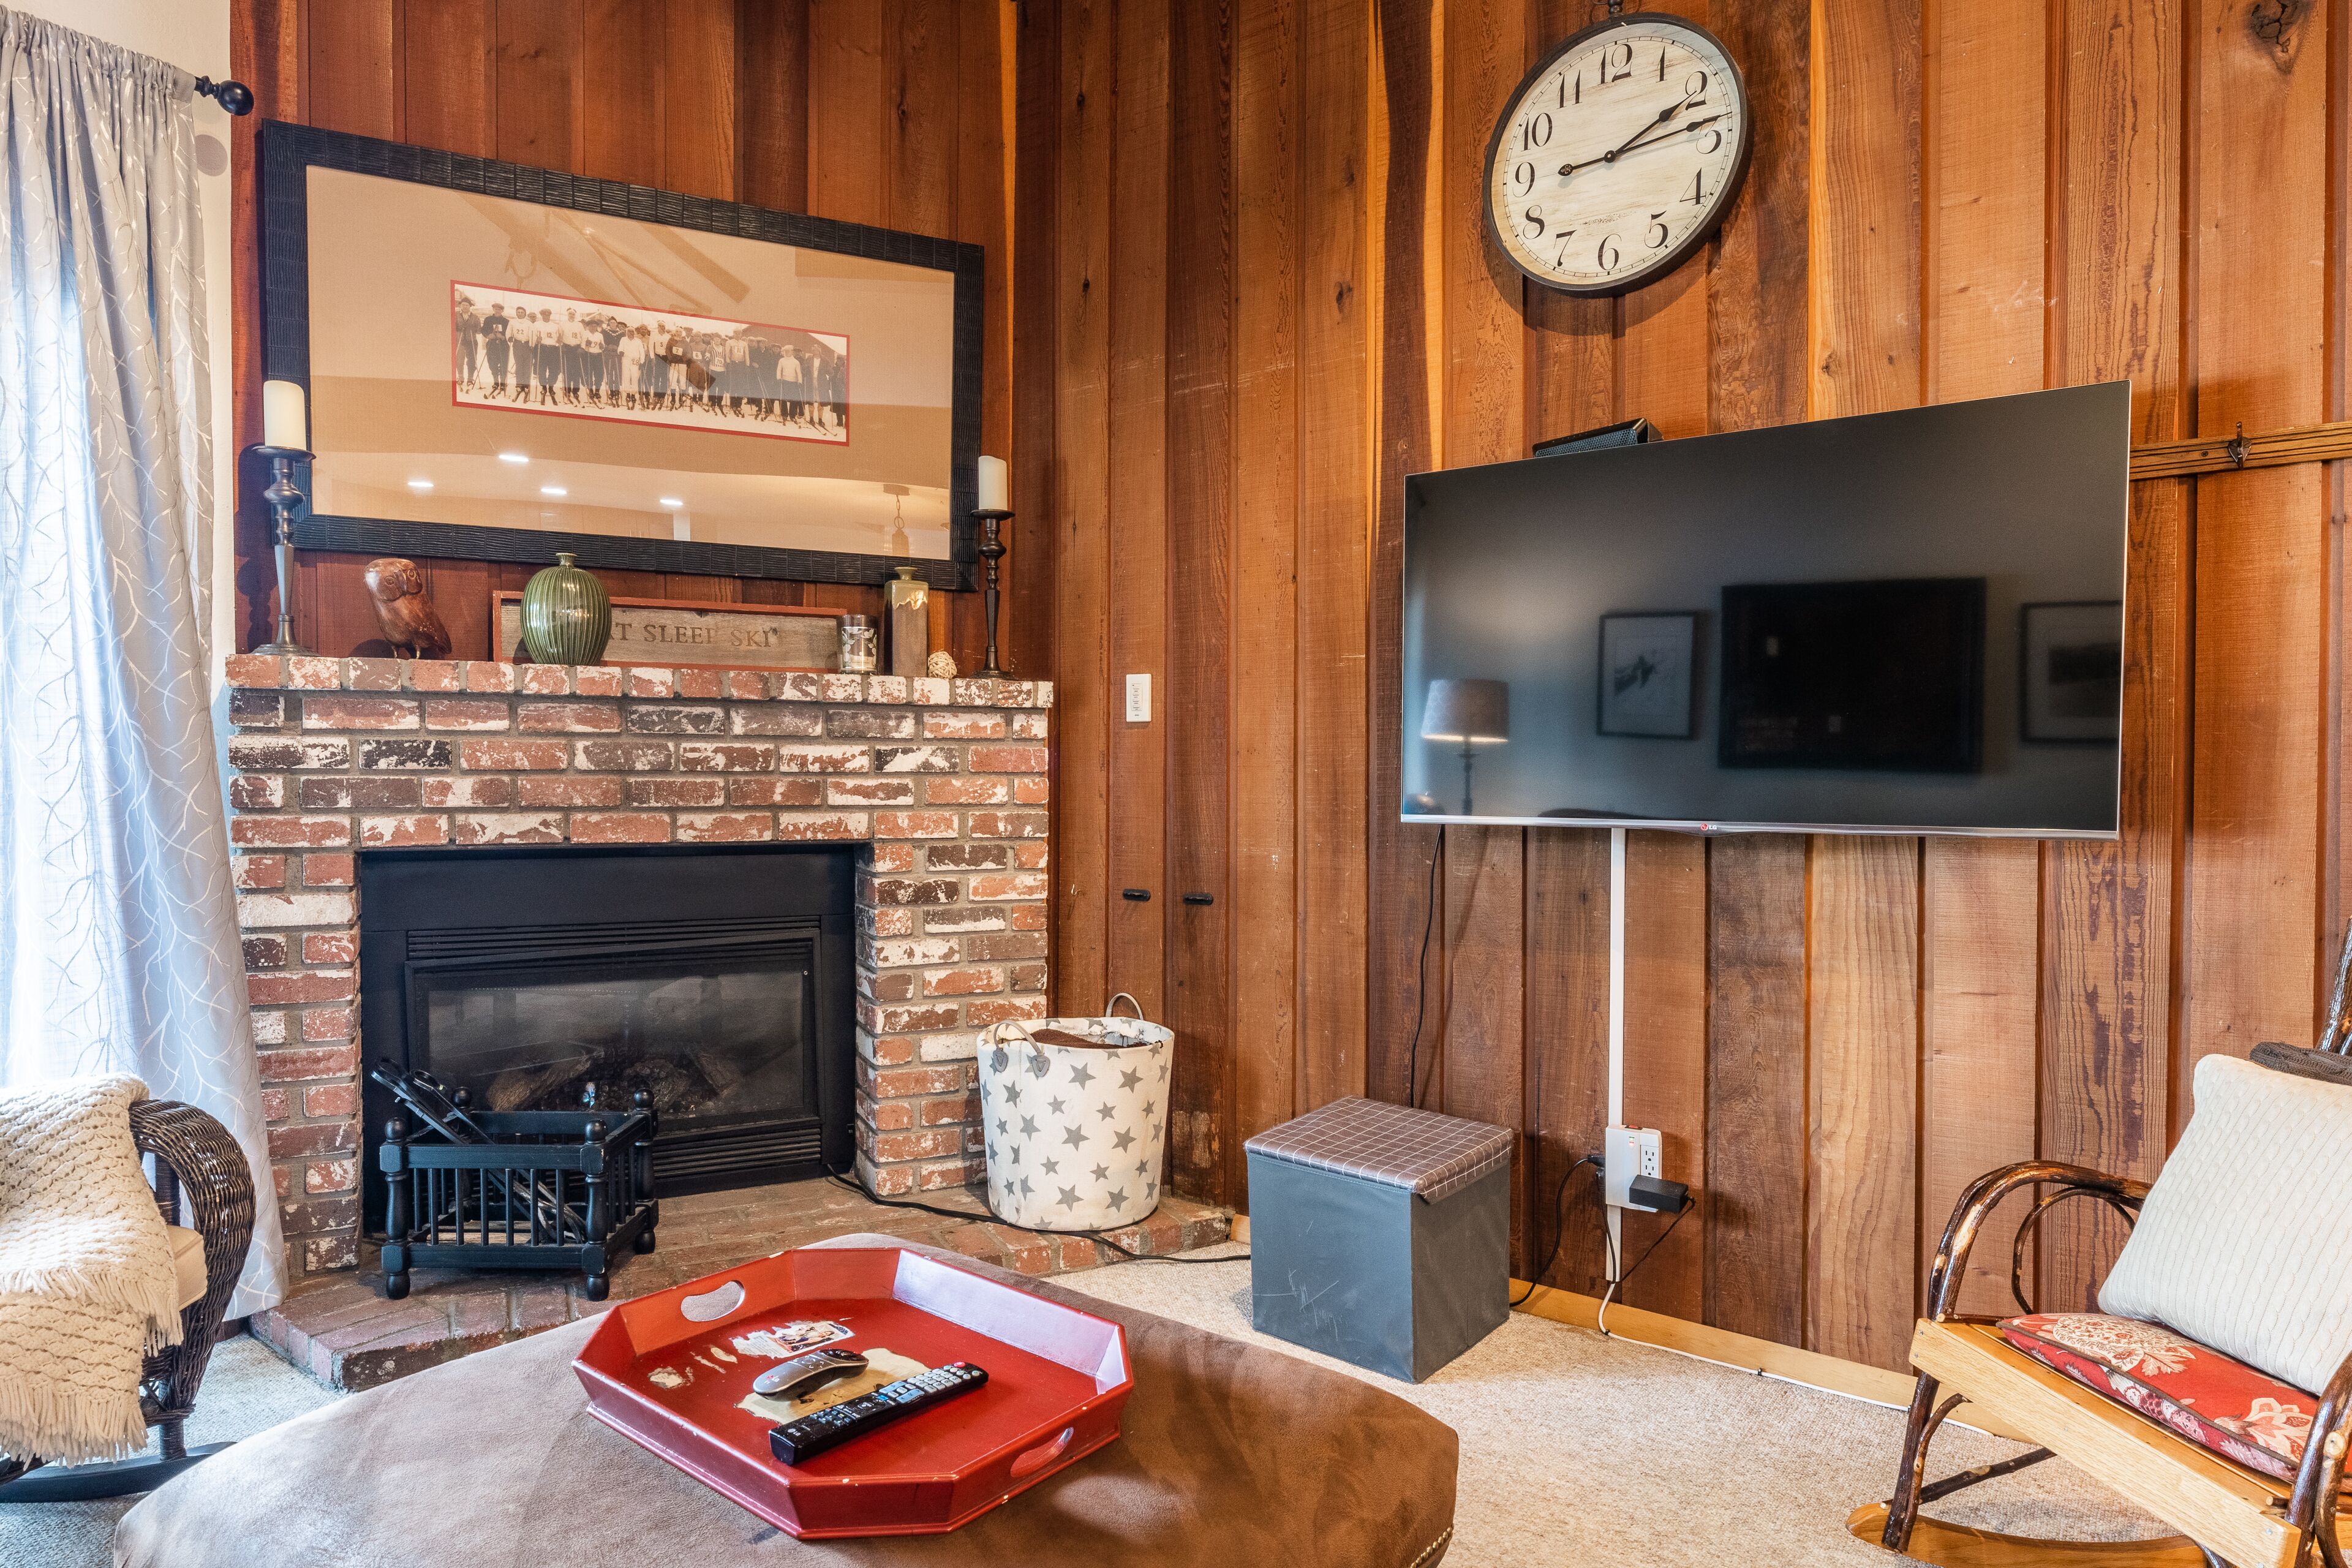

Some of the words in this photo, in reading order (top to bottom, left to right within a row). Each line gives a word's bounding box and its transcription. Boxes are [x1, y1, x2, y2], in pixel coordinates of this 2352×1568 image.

[1598, 43, 1633, 85] 12
[1656, 45, 1667, 83] 1
[1556, 69, 1582, 109] 11
[1684, 70, 1708, 111] 2
[1521, 112, 1553, 152] 10
[1695, 115, 1722, 154] 3
[1512, 161, 1536, 198] 9
[1679, 167, 1707, 206] 4
[1523, 205, 1545, 239] 8
[1645, 211, 1669, 249] 5
[1553, 230, 1577, 266] 7
[1598, 233, 1623, 271] 6
[730, 628, 771, 647] SKI
